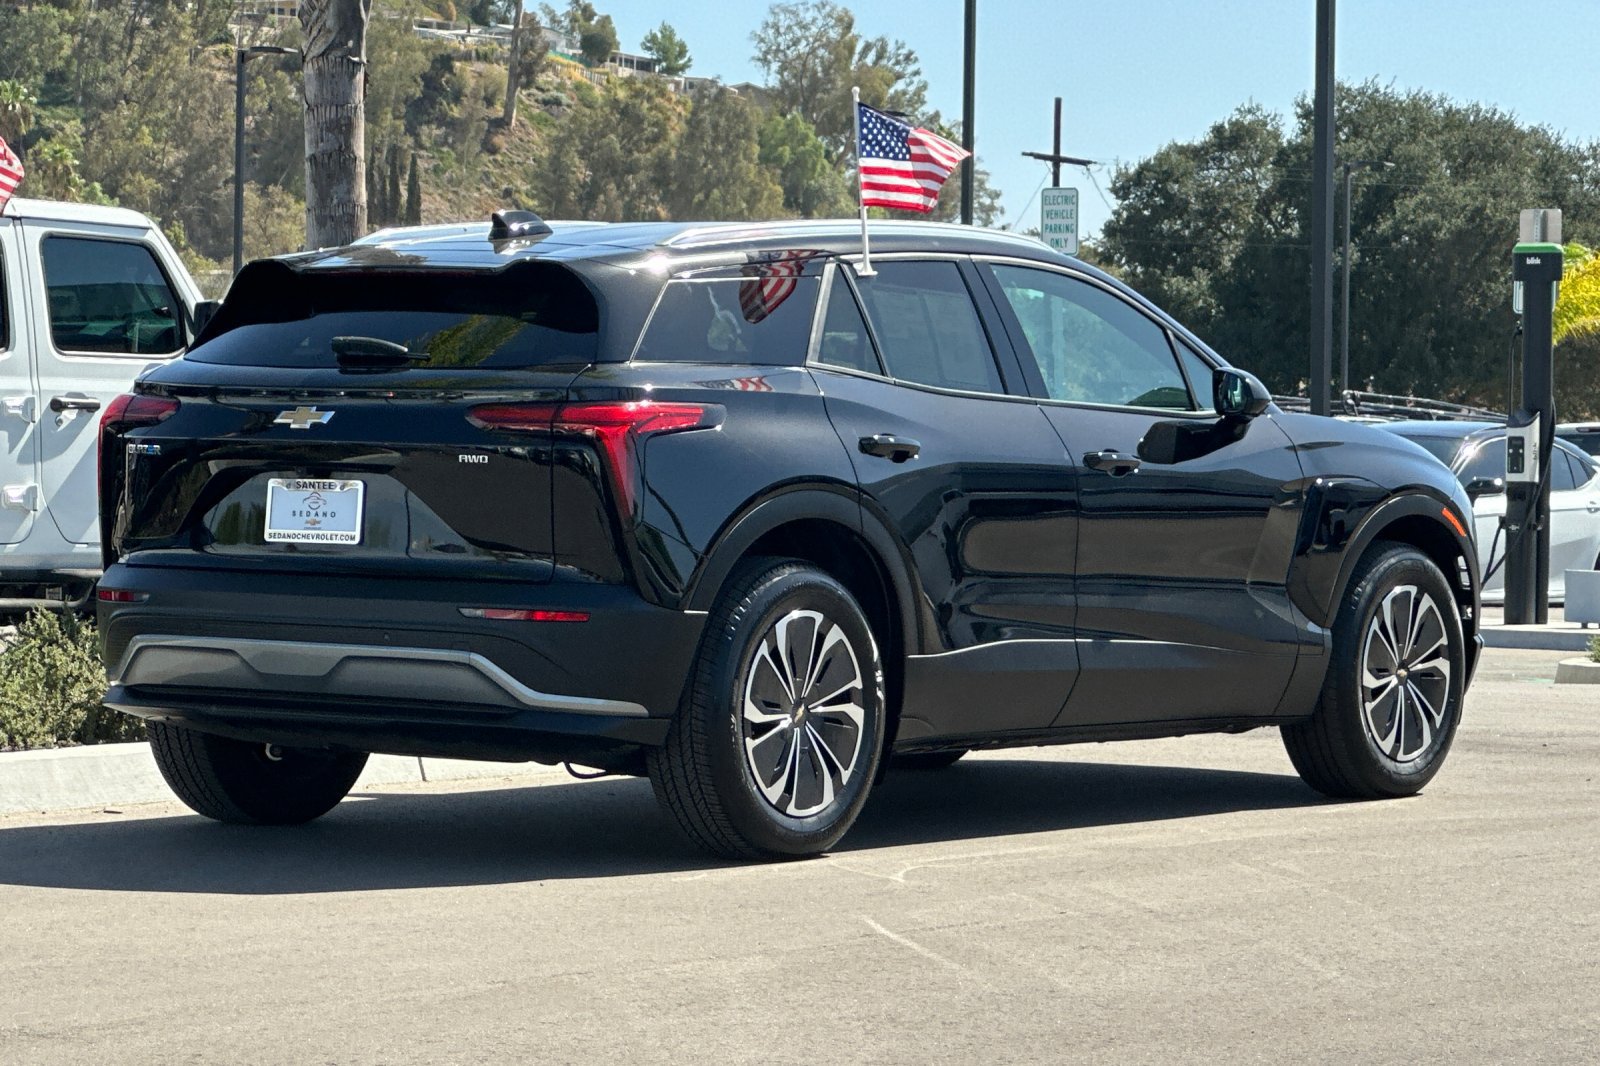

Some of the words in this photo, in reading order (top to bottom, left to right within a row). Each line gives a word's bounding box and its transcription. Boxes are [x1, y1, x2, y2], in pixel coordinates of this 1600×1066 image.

[1044, 194, 1076, 206] ELECTRIC
[1045, 209, 1075, 220] VEHICLE
[1044, 223, 1075, 234] PARKING
[1049, 238, 1069, 248] ONLY
[458, 454, 489, 464] AWD
[295, 480, 336, 490] SANTEE
[292, 509, 337, 518] SEDANO
[268, 531, 356, 542] SEDANOCHEVROLET.COM
